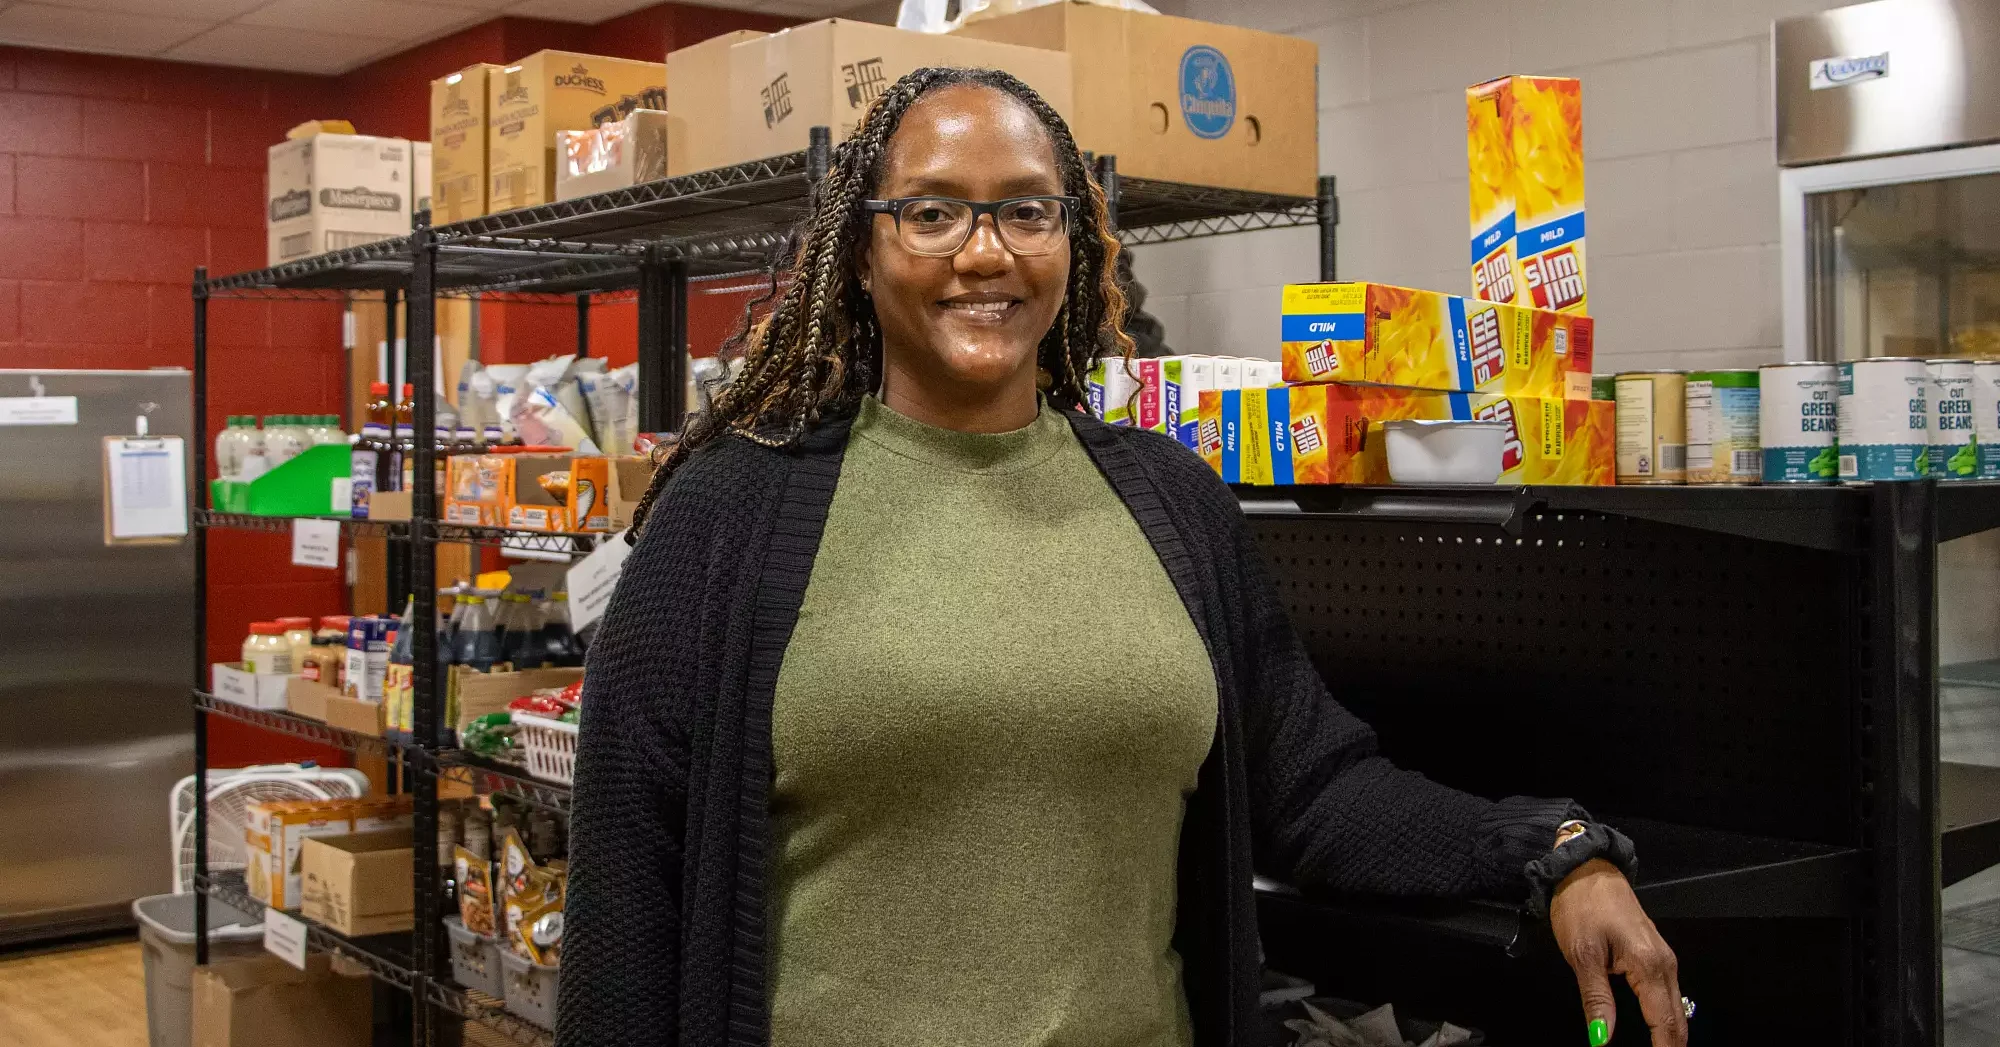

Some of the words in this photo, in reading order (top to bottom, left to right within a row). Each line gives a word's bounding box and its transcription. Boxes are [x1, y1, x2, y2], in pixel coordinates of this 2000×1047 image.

[555, 75, 605, 90] DUCHESS
[1484, 230, 1502, 248] MILD
[1540, 227, 1565, 243] MILD
[1309, 322, 1337, 332] MILD
[1457, 328, 1467, 361] MILD
[1813, 391, 1828, 401] CUT
[1917, 387, 1925, 397] CU
[1950, 388, 1964, 398] CUT
[1801, 403, 1837, 416] GREEN
[1909, 399, 1927, 413] GRE
[1939, 400, 1972, 414] GREEN
[1801, 419, 1837, 432] BEANS
[1909, 415, 1927, 429] BEA
[1939, 416, 1972, 430] BEANS
[1227, 422, 1235, 451] MILD
[1274, 421, 1285, 452] MILD
